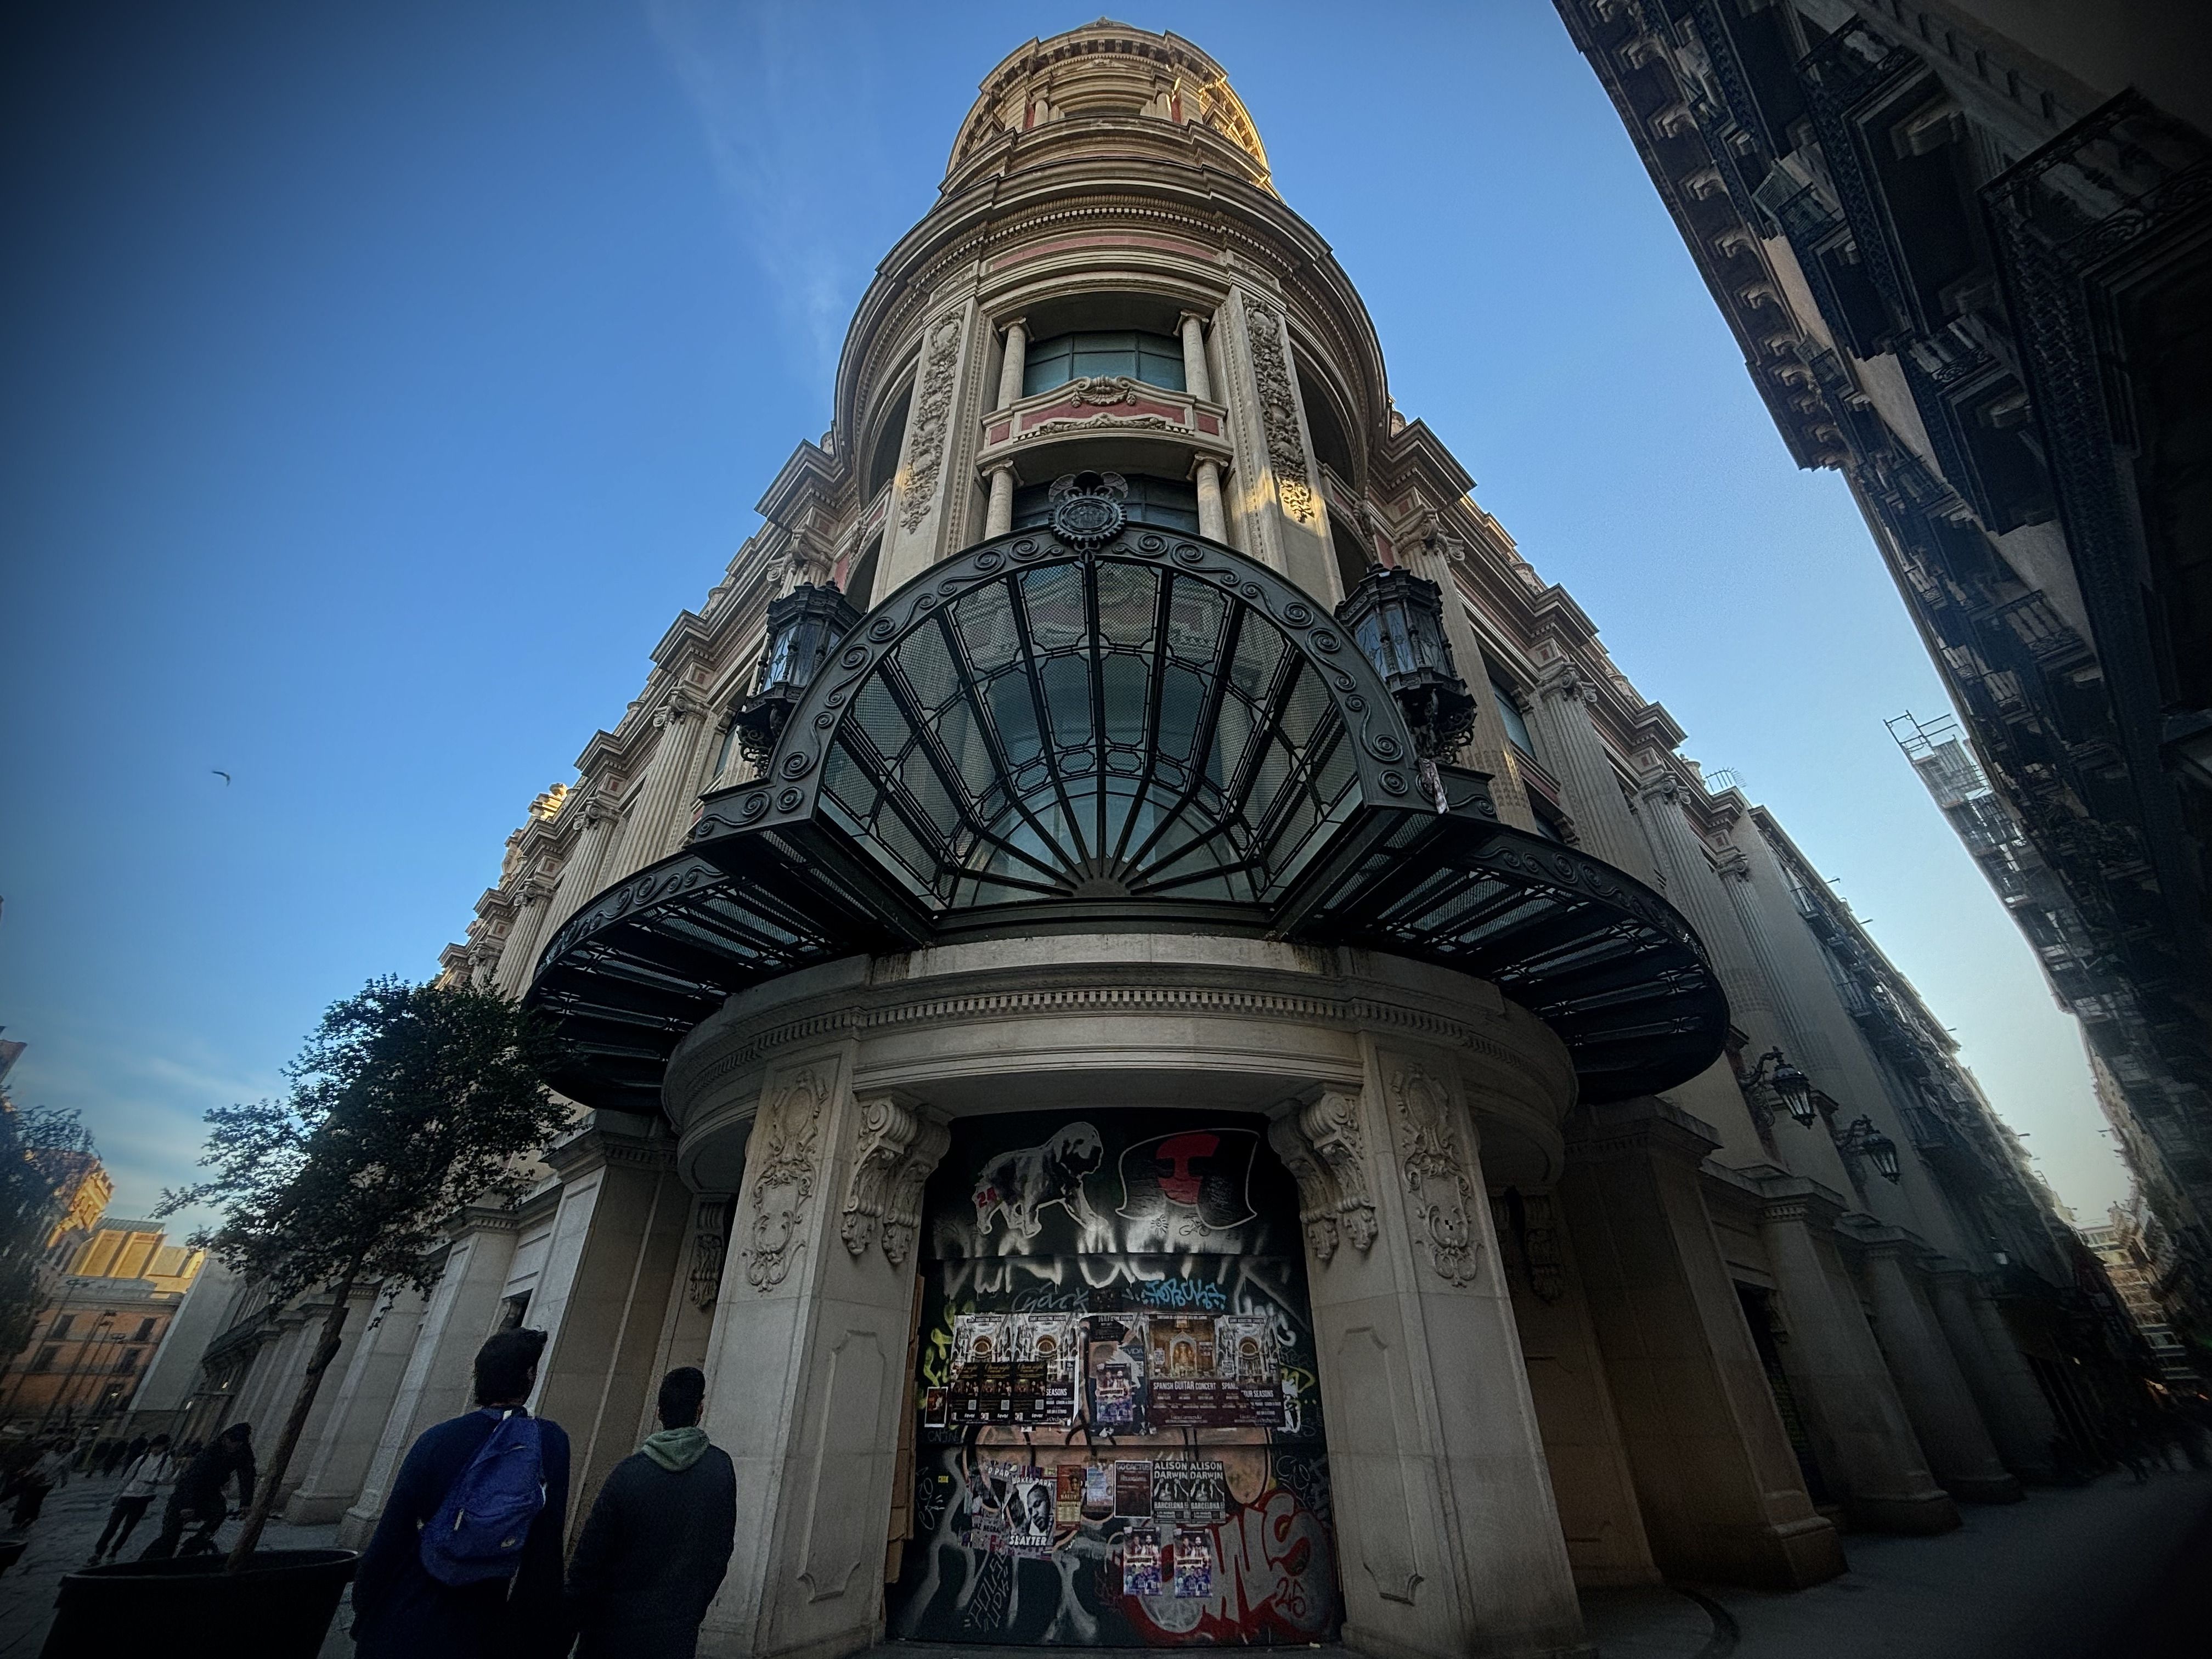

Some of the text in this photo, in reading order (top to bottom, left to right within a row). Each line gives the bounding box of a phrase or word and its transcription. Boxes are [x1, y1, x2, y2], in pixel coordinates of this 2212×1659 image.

[1153, 1381, 1216, 1390] SPANISH GUITAR CONCERT
[1046, 1388, 1068, 1396] SEASONS
[1154, 1462, 1187, 1471] ALISON
[1190, 1462, 1222, 1471] ALISON
[1154, 1471, 1189, 1480] DARWIN
[1190, 1471, 1223, 1480] DARWIN
[1035, 1477, 1053, 1488] PARK
[1009, 1536, 1047, 1546] SLAYTER
